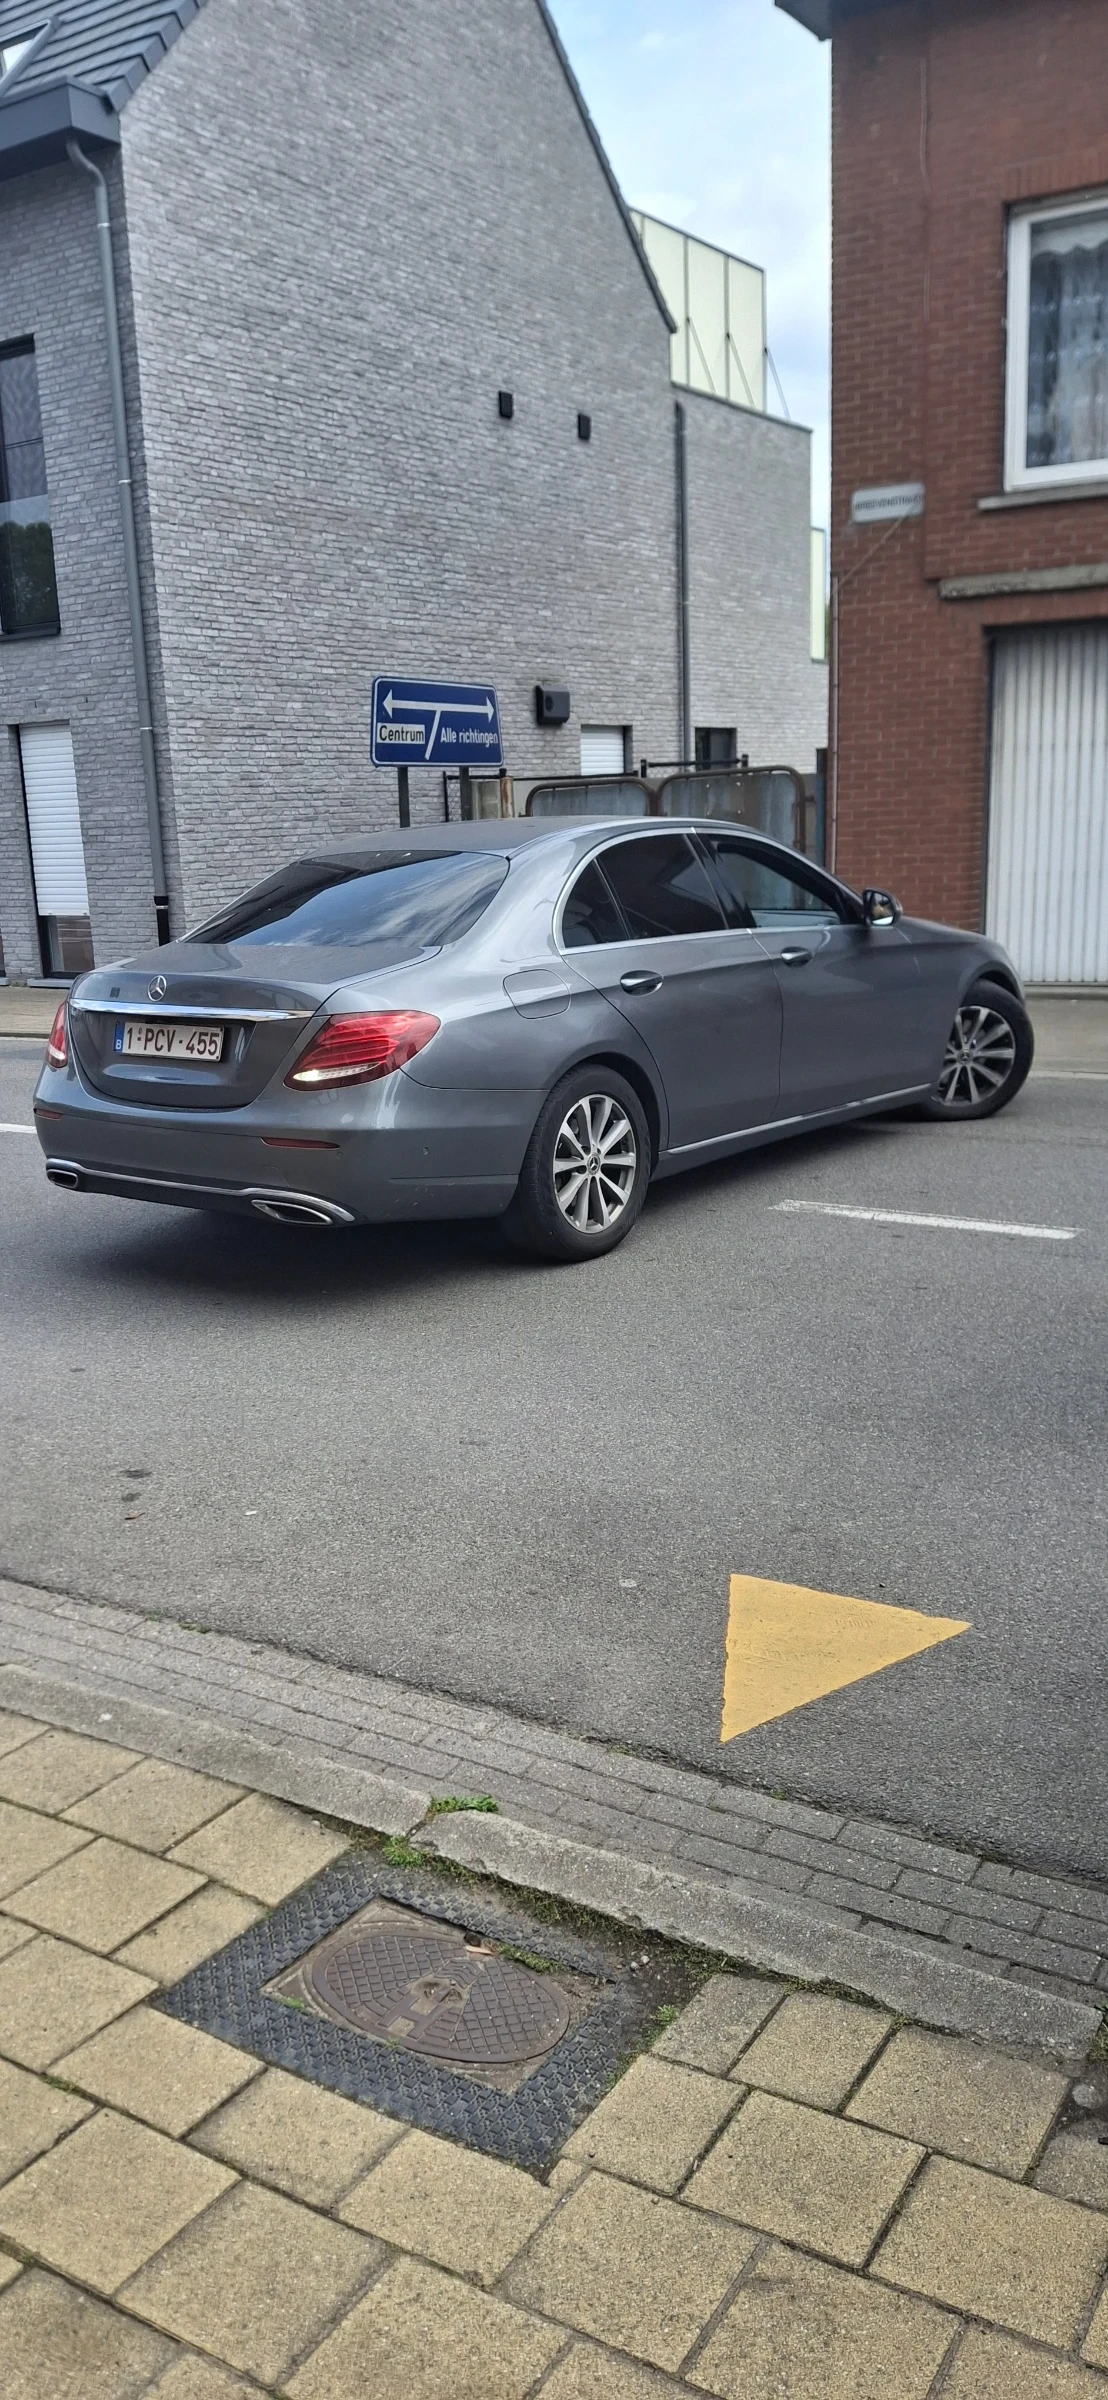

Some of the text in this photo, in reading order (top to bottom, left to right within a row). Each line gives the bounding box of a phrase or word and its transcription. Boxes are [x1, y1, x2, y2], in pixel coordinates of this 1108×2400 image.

[378, 724, 425, 743] Centrum
[440, 727, 499, 748] Alle richtingen
[115, 1039, 122, 1050] B
